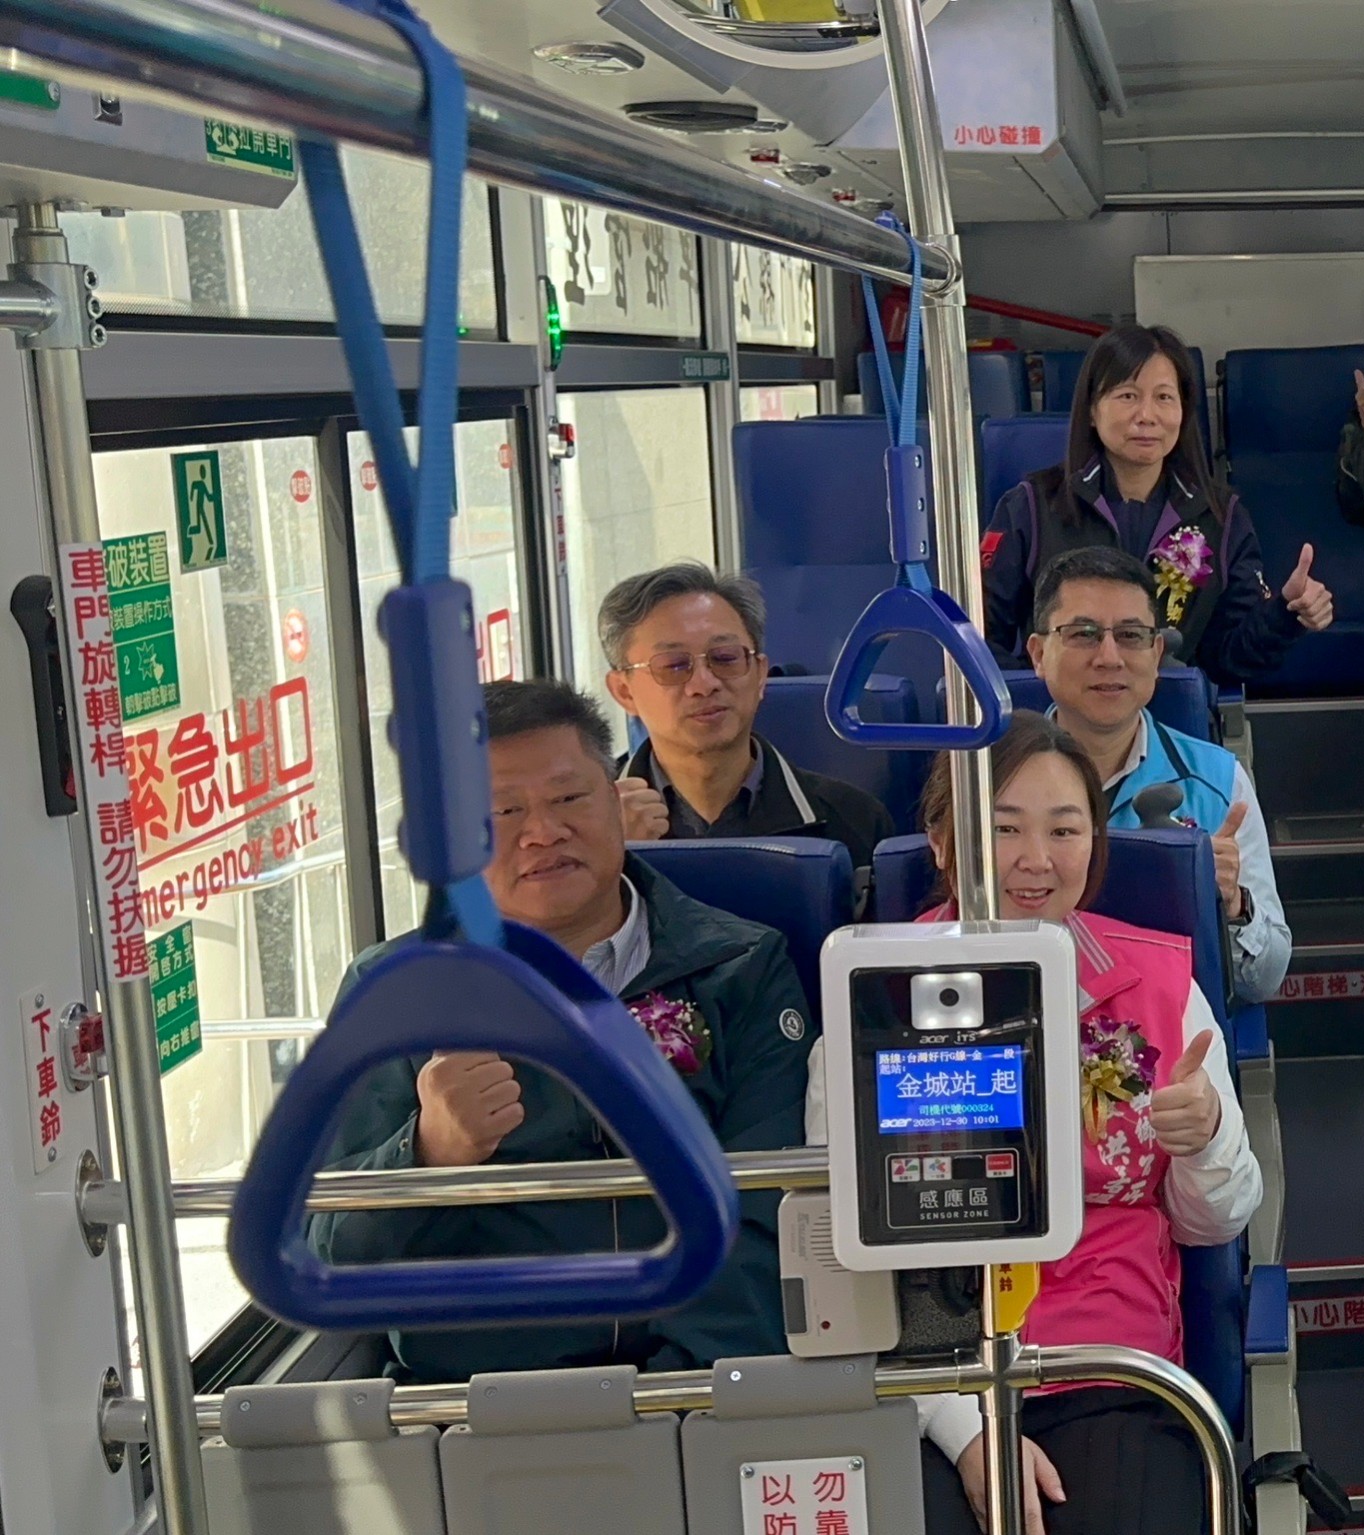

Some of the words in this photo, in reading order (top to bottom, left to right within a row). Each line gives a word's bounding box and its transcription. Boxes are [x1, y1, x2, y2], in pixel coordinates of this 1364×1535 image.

[955, 125, 1041, 145] 小心碰撞
[103, 534, 171, 588] 破裝置
[109, 595, 172, 632] 裝置操作方式
[68, 548, 127, 777] 車門旋轉桿
[122, 676, 314, 855] 緊急出口
[140, 836, 263, 928] mergency
[273, 799, 319, 861] exit
[97, 798, 149, 978] 請勿扶握
[919, 1034, 949, 1044] acer
[31, 1008, 61, 1147] 下車鈴
[896, 1068, 1017, 1098] 金城站_起
[880, 1118, 912, 1128] acer
[973, 1115, 999, 1124] 10:01
[919, 1187, 989, 1209] 感應區
[919, 1211, 960, 1220] SENSOR
[963, 1210, 989, 1218] ZONE
